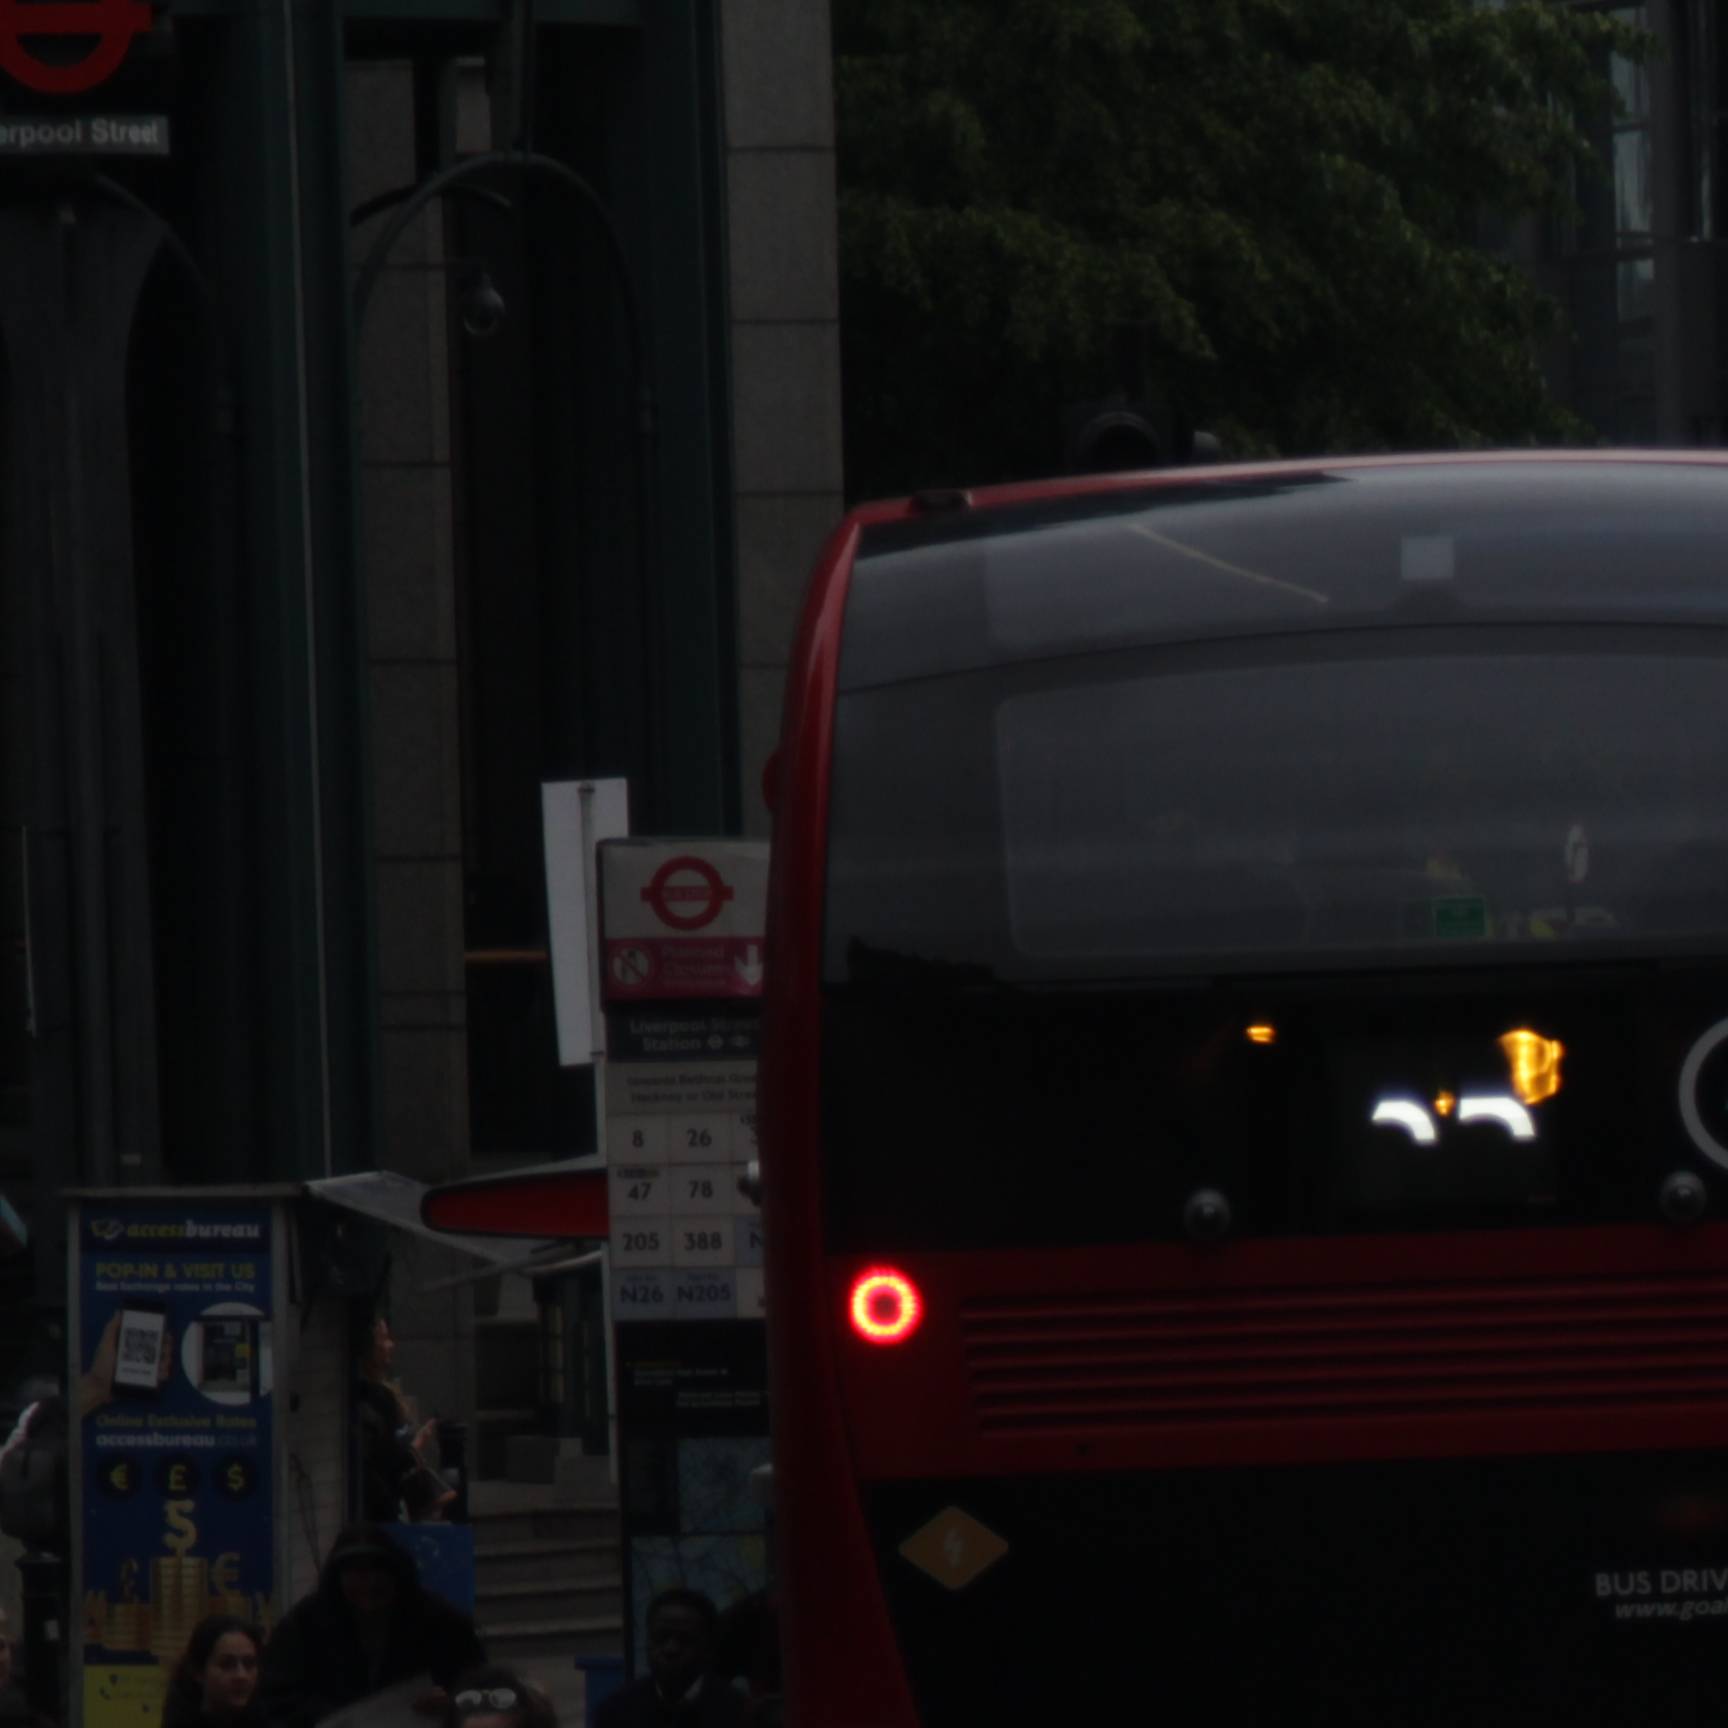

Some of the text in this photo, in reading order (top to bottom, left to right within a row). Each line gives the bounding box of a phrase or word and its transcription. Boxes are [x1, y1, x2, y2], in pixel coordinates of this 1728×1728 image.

[91, 118, 159, 145] Street
[629, 1018, 706, 1036] Liverpool
[642, 1035, 702, 1051] Station
[631, 1127, 713, 1149] 8 26
[626, 1178, 715, 1201] 47 78
[127, 1219, 262, 1240] accessbureau
[621, 1230, 661, 1252] 205
[684, 1230, 724, 1251] 388
[96, 1261, 257, 1280] POP-IN & VISIT US
[619, 1282, 733, 1304] N26 N205
[167, 1464, 189, 1492] £
[226, 1462, 247, 1493] $
[1595, 1569, 1652, 1597] BUS
